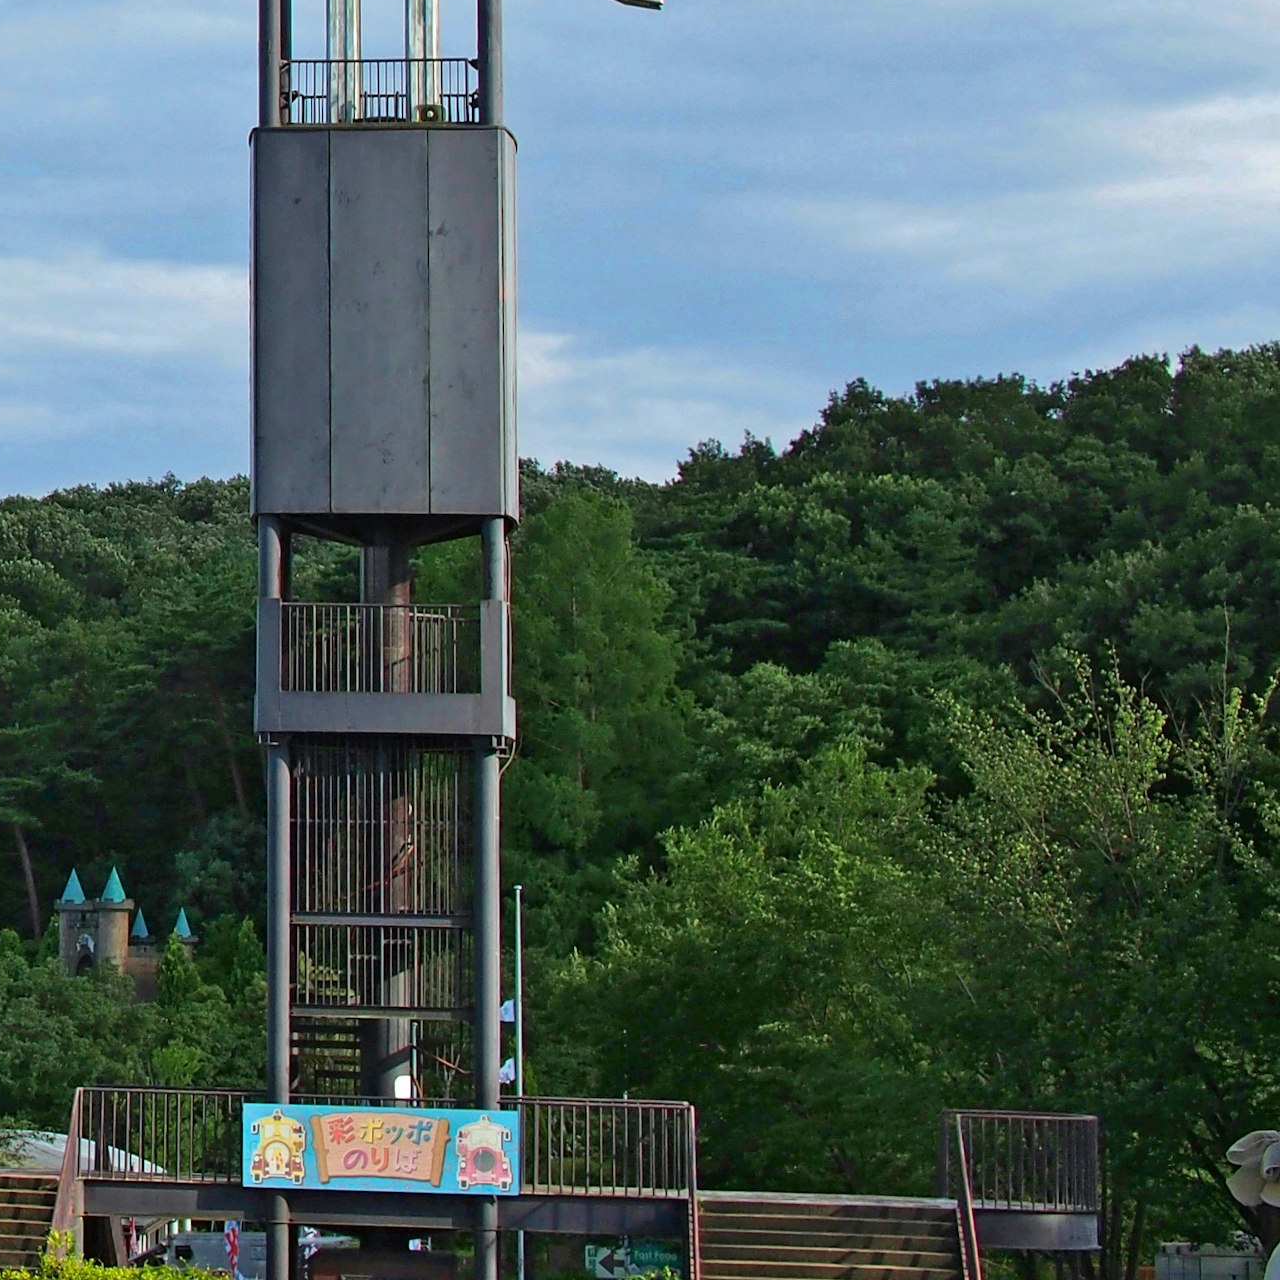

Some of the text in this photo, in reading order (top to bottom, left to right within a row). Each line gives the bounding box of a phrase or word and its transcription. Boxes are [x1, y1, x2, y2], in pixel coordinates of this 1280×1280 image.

[328, 1116, 433, 1145] 彩ポッポ
[342, 1147, 421, 1173] のりば
